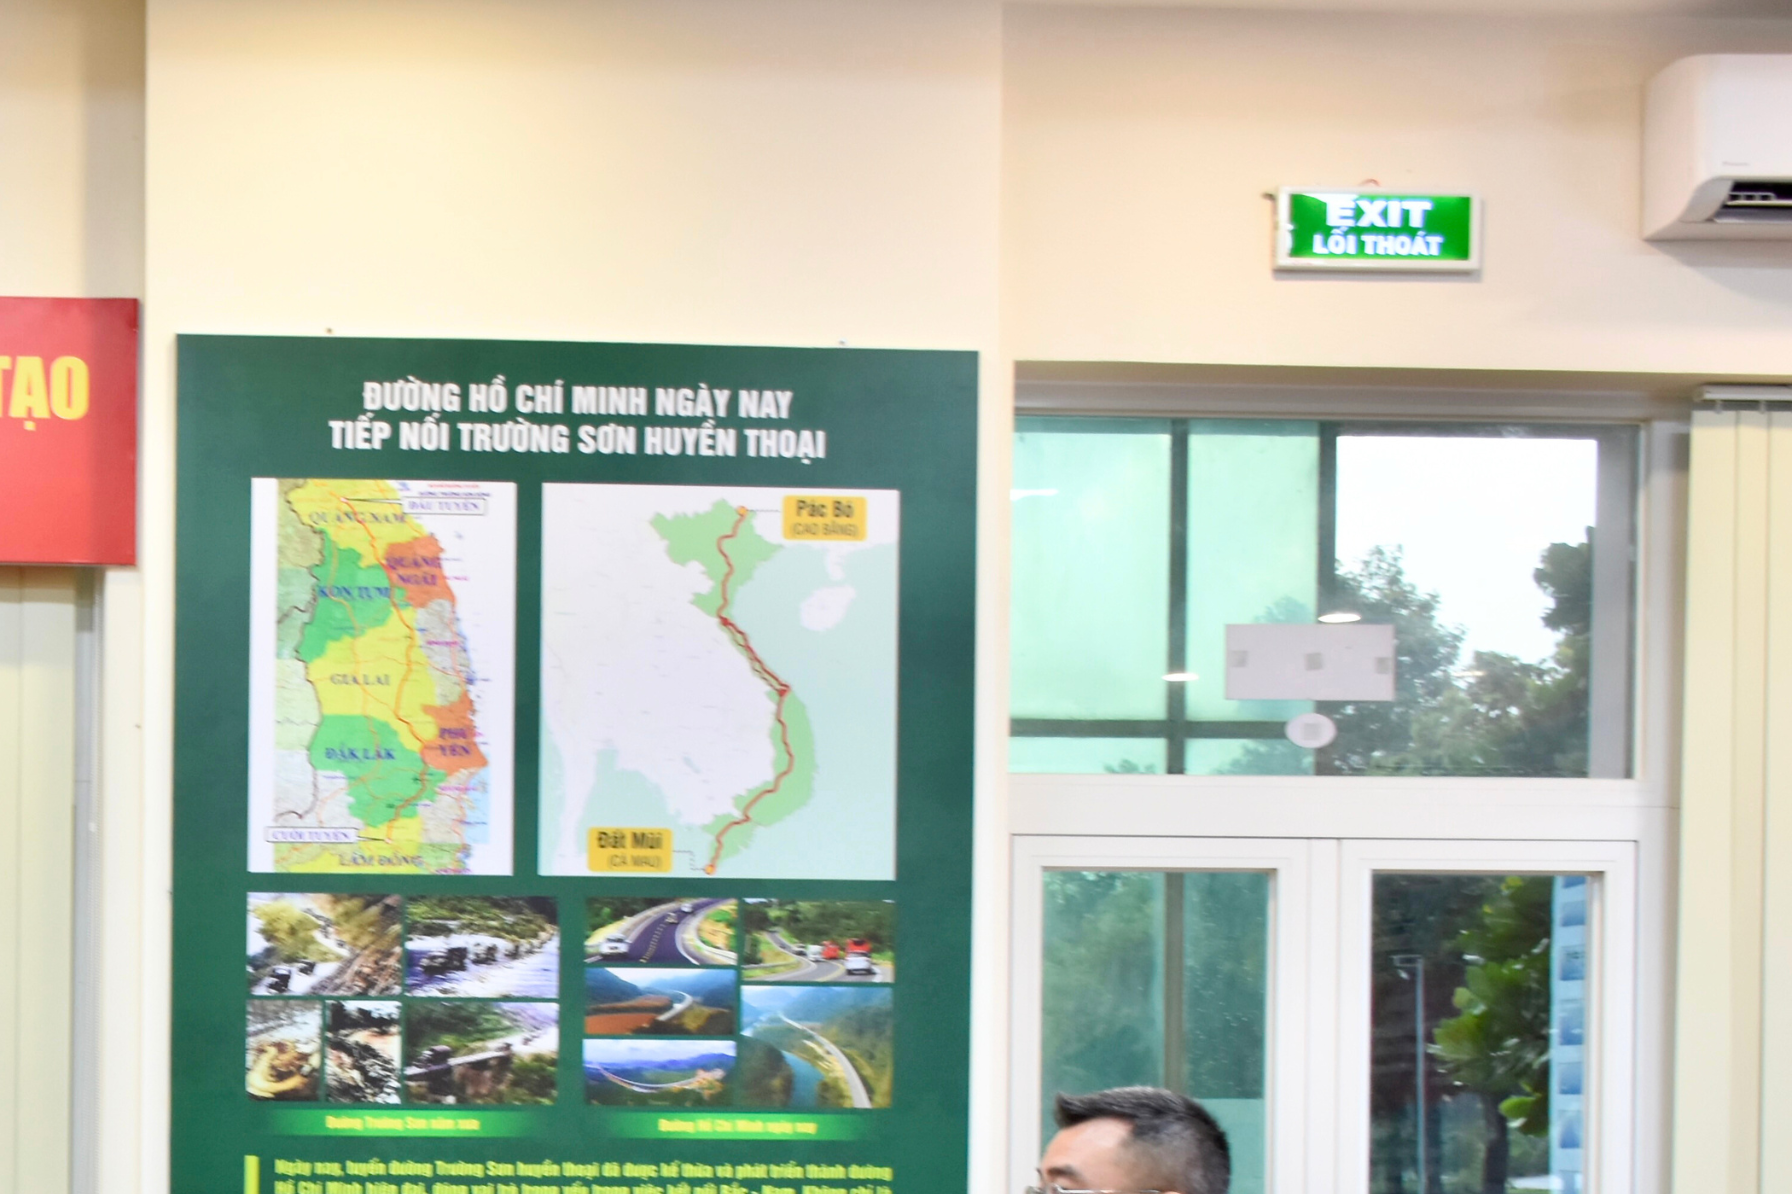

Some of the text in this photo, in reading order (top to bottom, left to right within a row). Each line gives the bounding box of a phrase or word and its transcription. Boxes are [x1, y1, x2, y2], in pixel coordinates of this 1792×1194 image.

[1326, 199, 1433, 228] EXIT
[1312, 227, 1444, 256] LỐI THOÁT
[362, 374, 794, 419] ĐƯỜNG HỒ CHÍ MINH NGÀY NAY
[328, 412, 827, 465] TIẾP NỐI TRƯỜNG SƠN HUYỀN THOẠI
